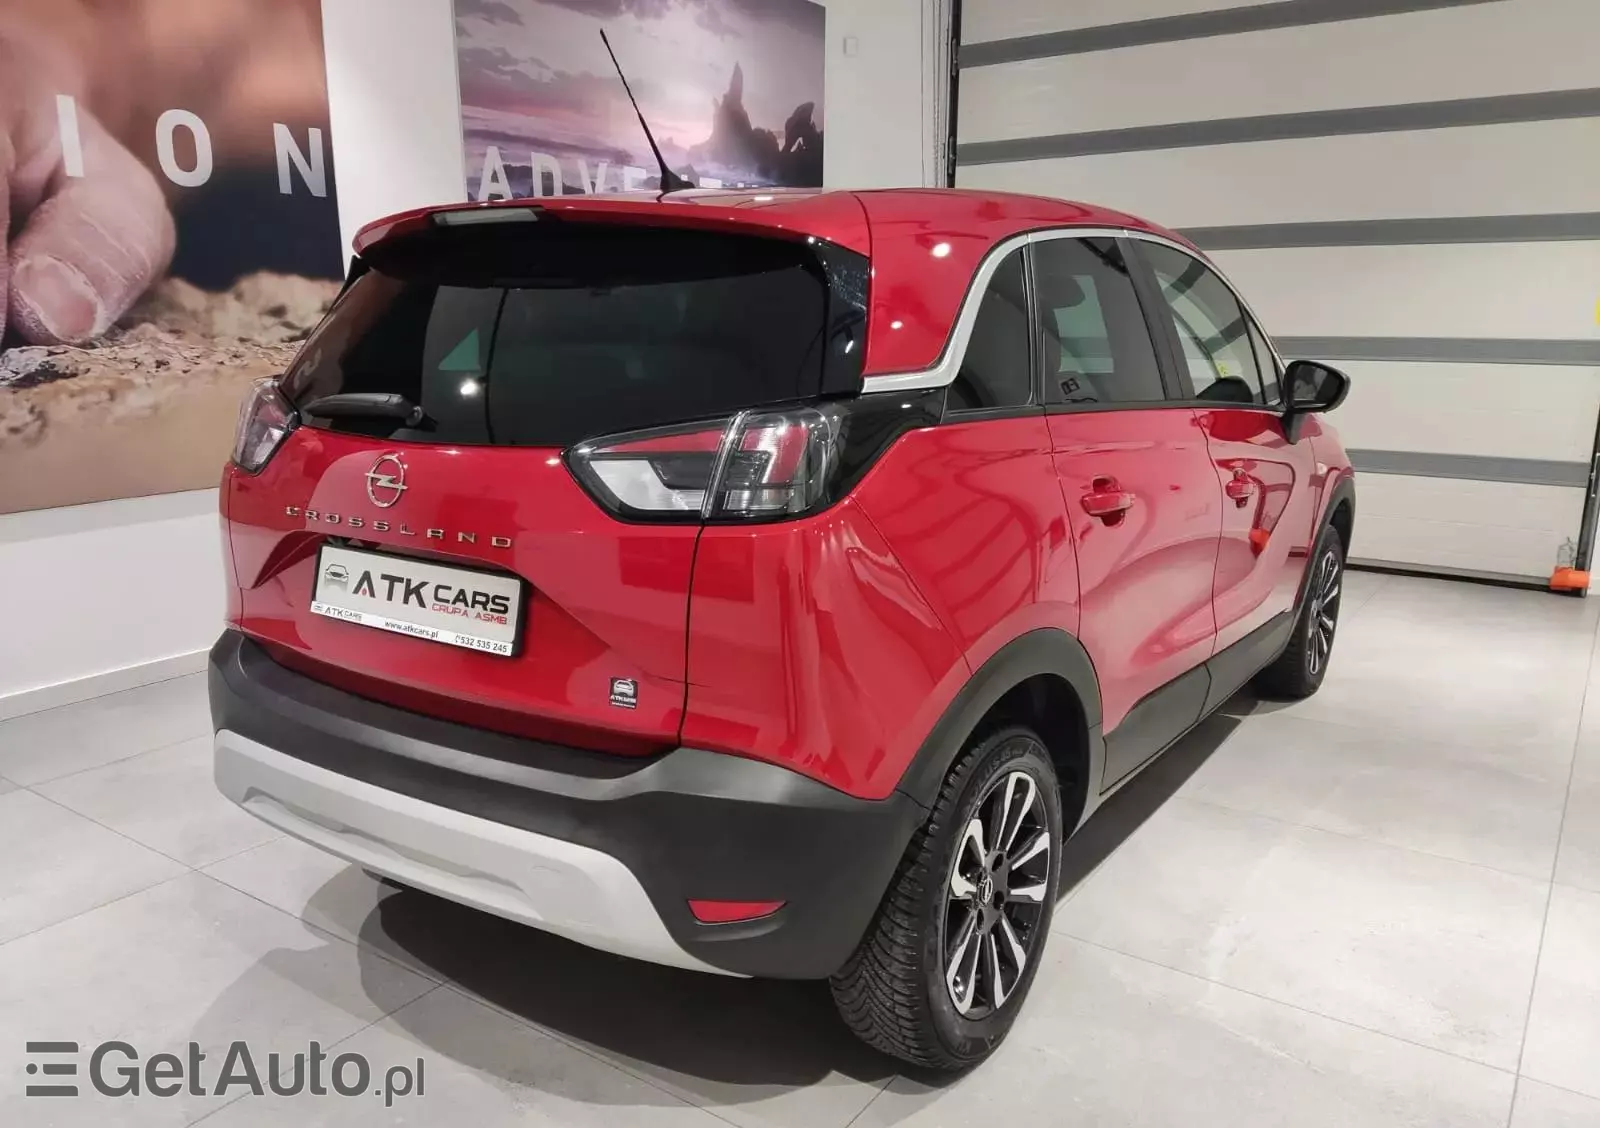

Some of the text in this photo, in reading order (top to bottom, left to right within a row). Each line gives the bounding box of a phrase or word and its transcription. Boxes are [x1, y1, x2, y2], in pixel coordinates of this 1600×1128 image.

[285, 506, 512, 549] CROSSLAND
[352, 570, 510, 615] ATK CARS
[324, 606, 344, 618] ATK
[474, 612, 508, 625] ASMB
[384, 620, 439, 639] www.atkcars.pl
[460, 636, 508, 653] 532 535 245
